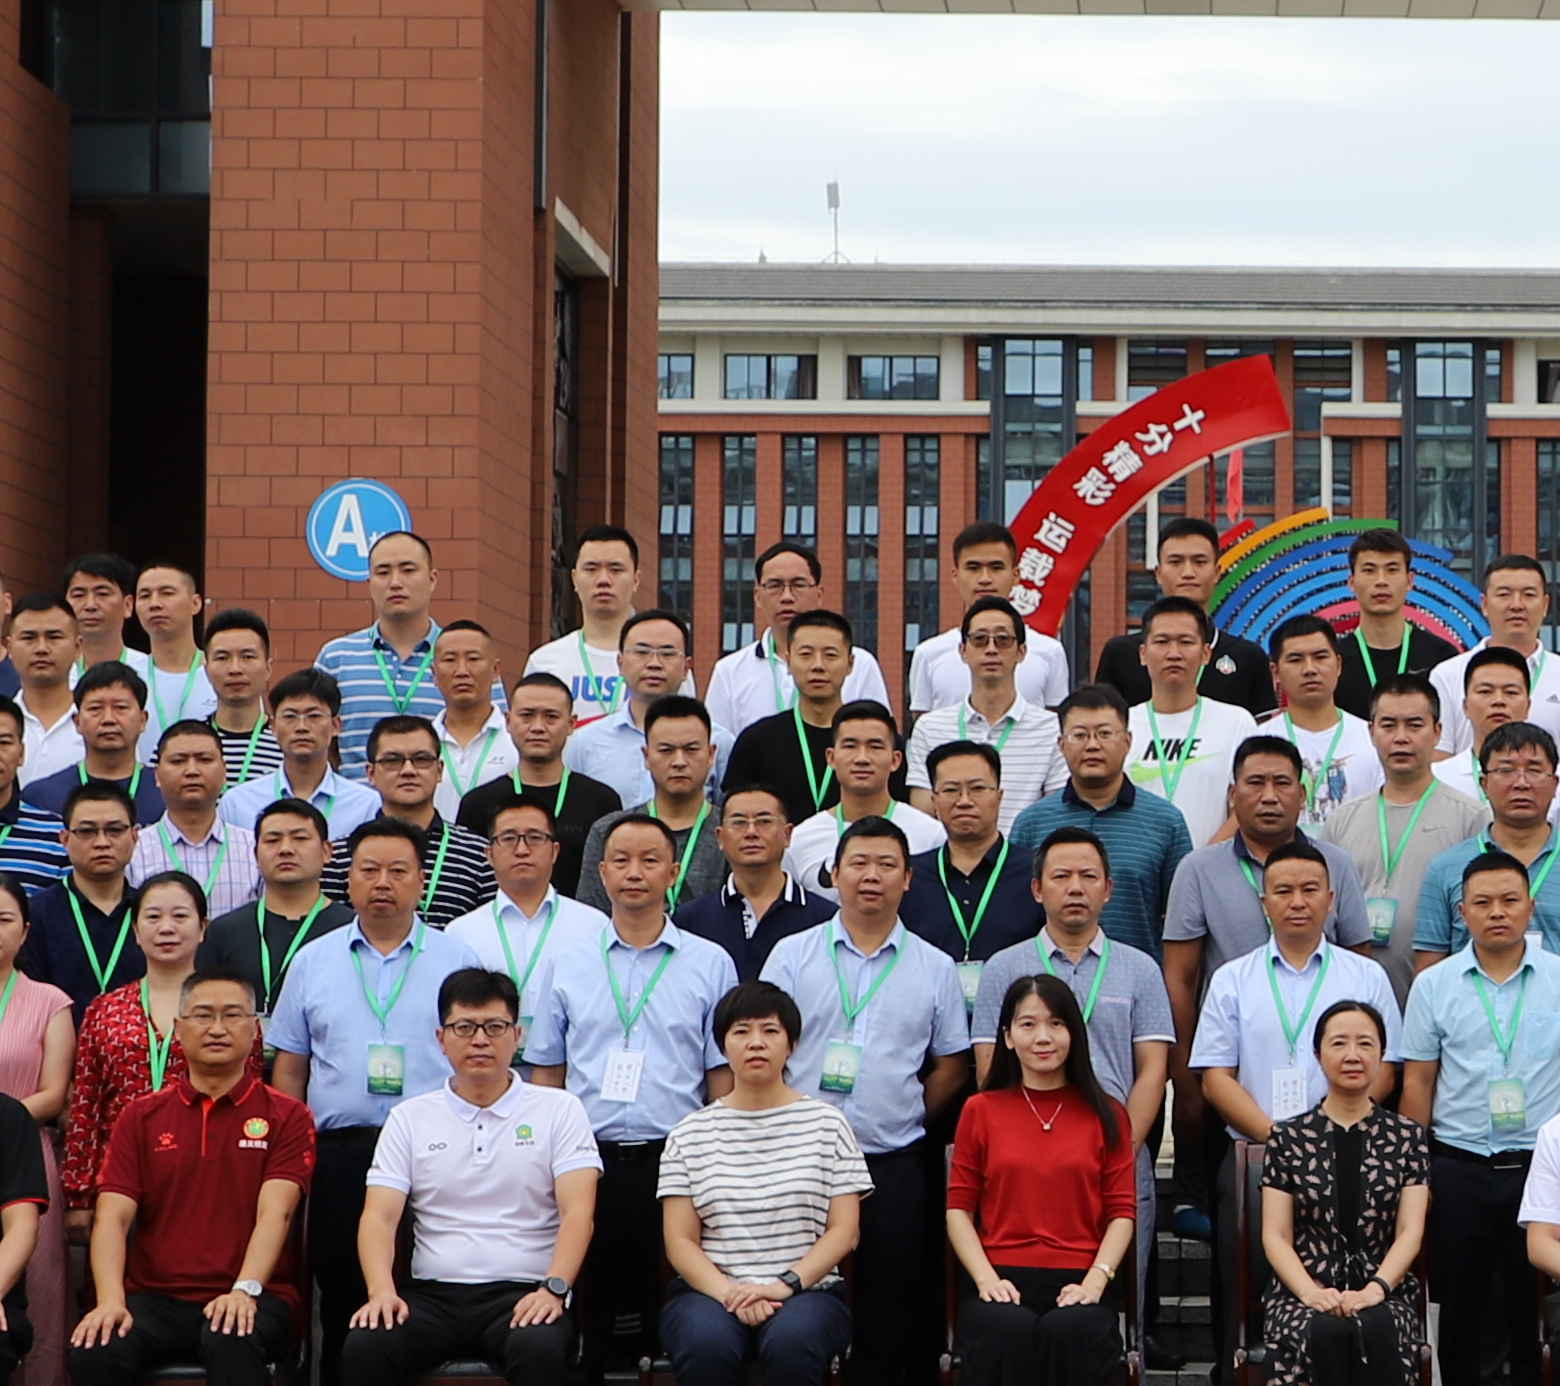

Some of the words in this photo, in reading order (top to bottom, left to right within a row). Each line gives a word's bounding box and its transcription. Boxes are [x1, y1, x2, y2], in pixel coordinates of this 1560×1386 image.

[1072, 402, 1206, 506] 十分精彩
[325, 493, 387, 558] A
[570, 675, 632, 704] JUS
[1141, 738, 1201, 762] NIKE
